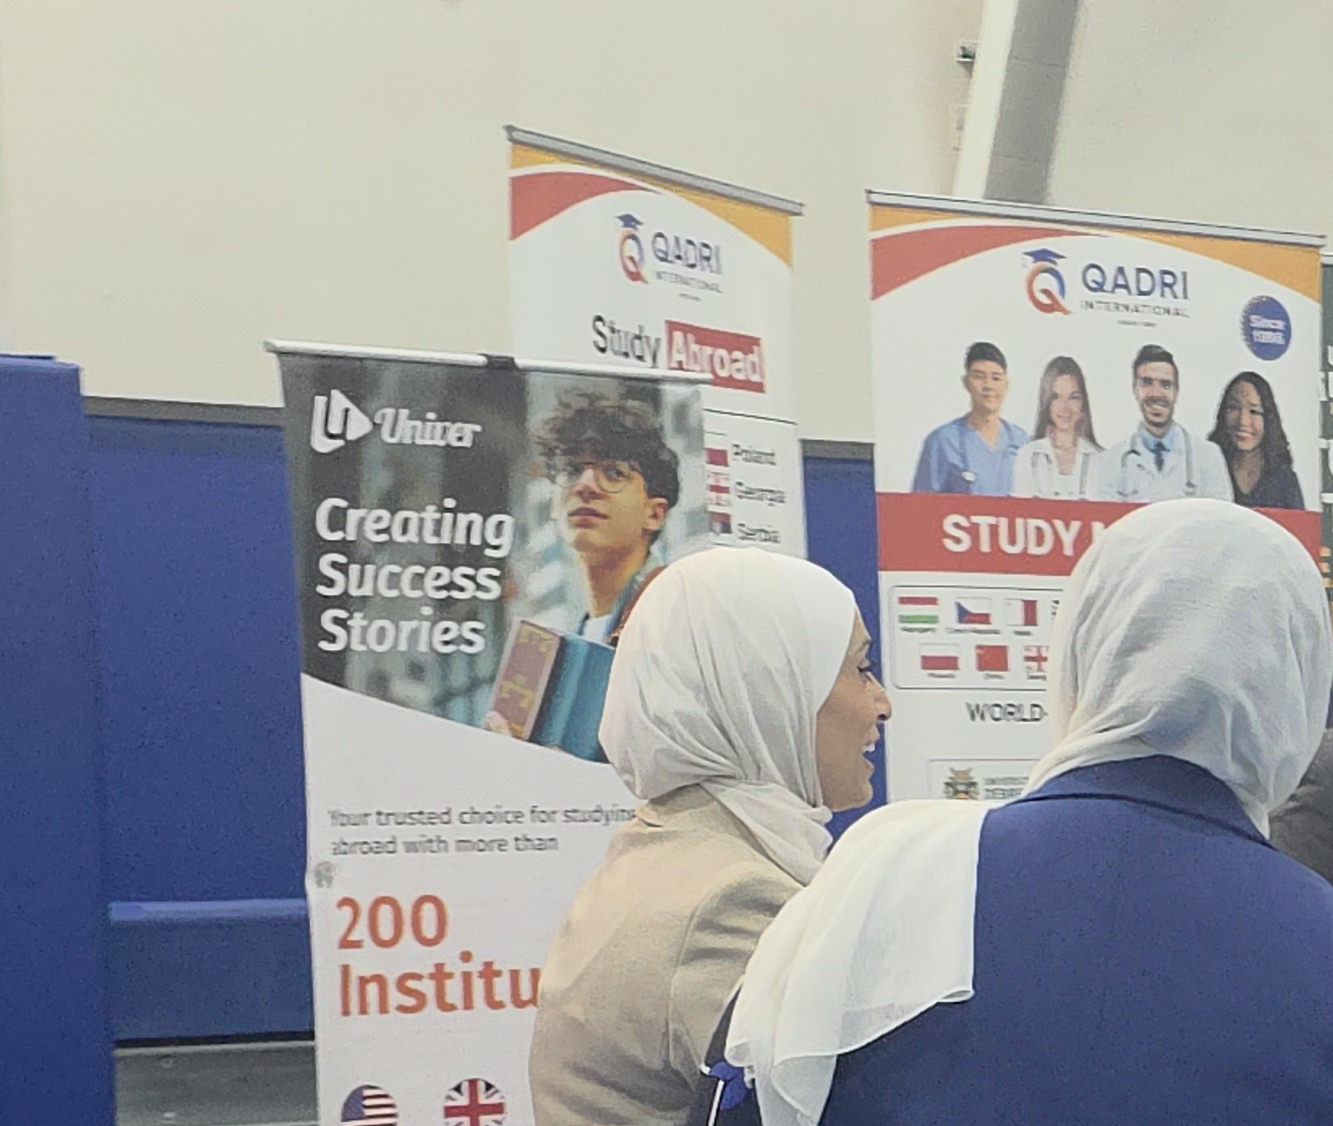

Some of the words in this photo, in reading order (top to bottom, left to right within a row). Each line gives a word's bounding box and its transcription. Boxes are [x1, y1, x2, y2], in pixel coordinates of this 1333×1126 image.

[652, 231, 723, 275] QADRI
[1082, 263, 1190, 300] QADRI
[1079, 300, 1190, 318] INTERNATIONAL
[592, 314, 661, 369] Study
[670, 330, 763, 382] Abroad
[374, 407, 482, 448] Univer
[316, 497, 515, 558] Creating
[942, 514, 1082, 557] STUDY
[315, 552, 501, 601] Success
[317, 605, 487, 654] Stories
[328, 809, 372, 827] Your
[375, 806, 453, 826] trusted
[458, 805, 524, 825] choice
[530, 804, 558, 824] for
[330, 835, 397, 856] abroad
[401, 834, 449, 853] with
[454, 838, 509, 852] more
[514, 833, 559, 851] than
[336, 894, 448, 950] 200
[338, 950, 542, 1017] Institu
